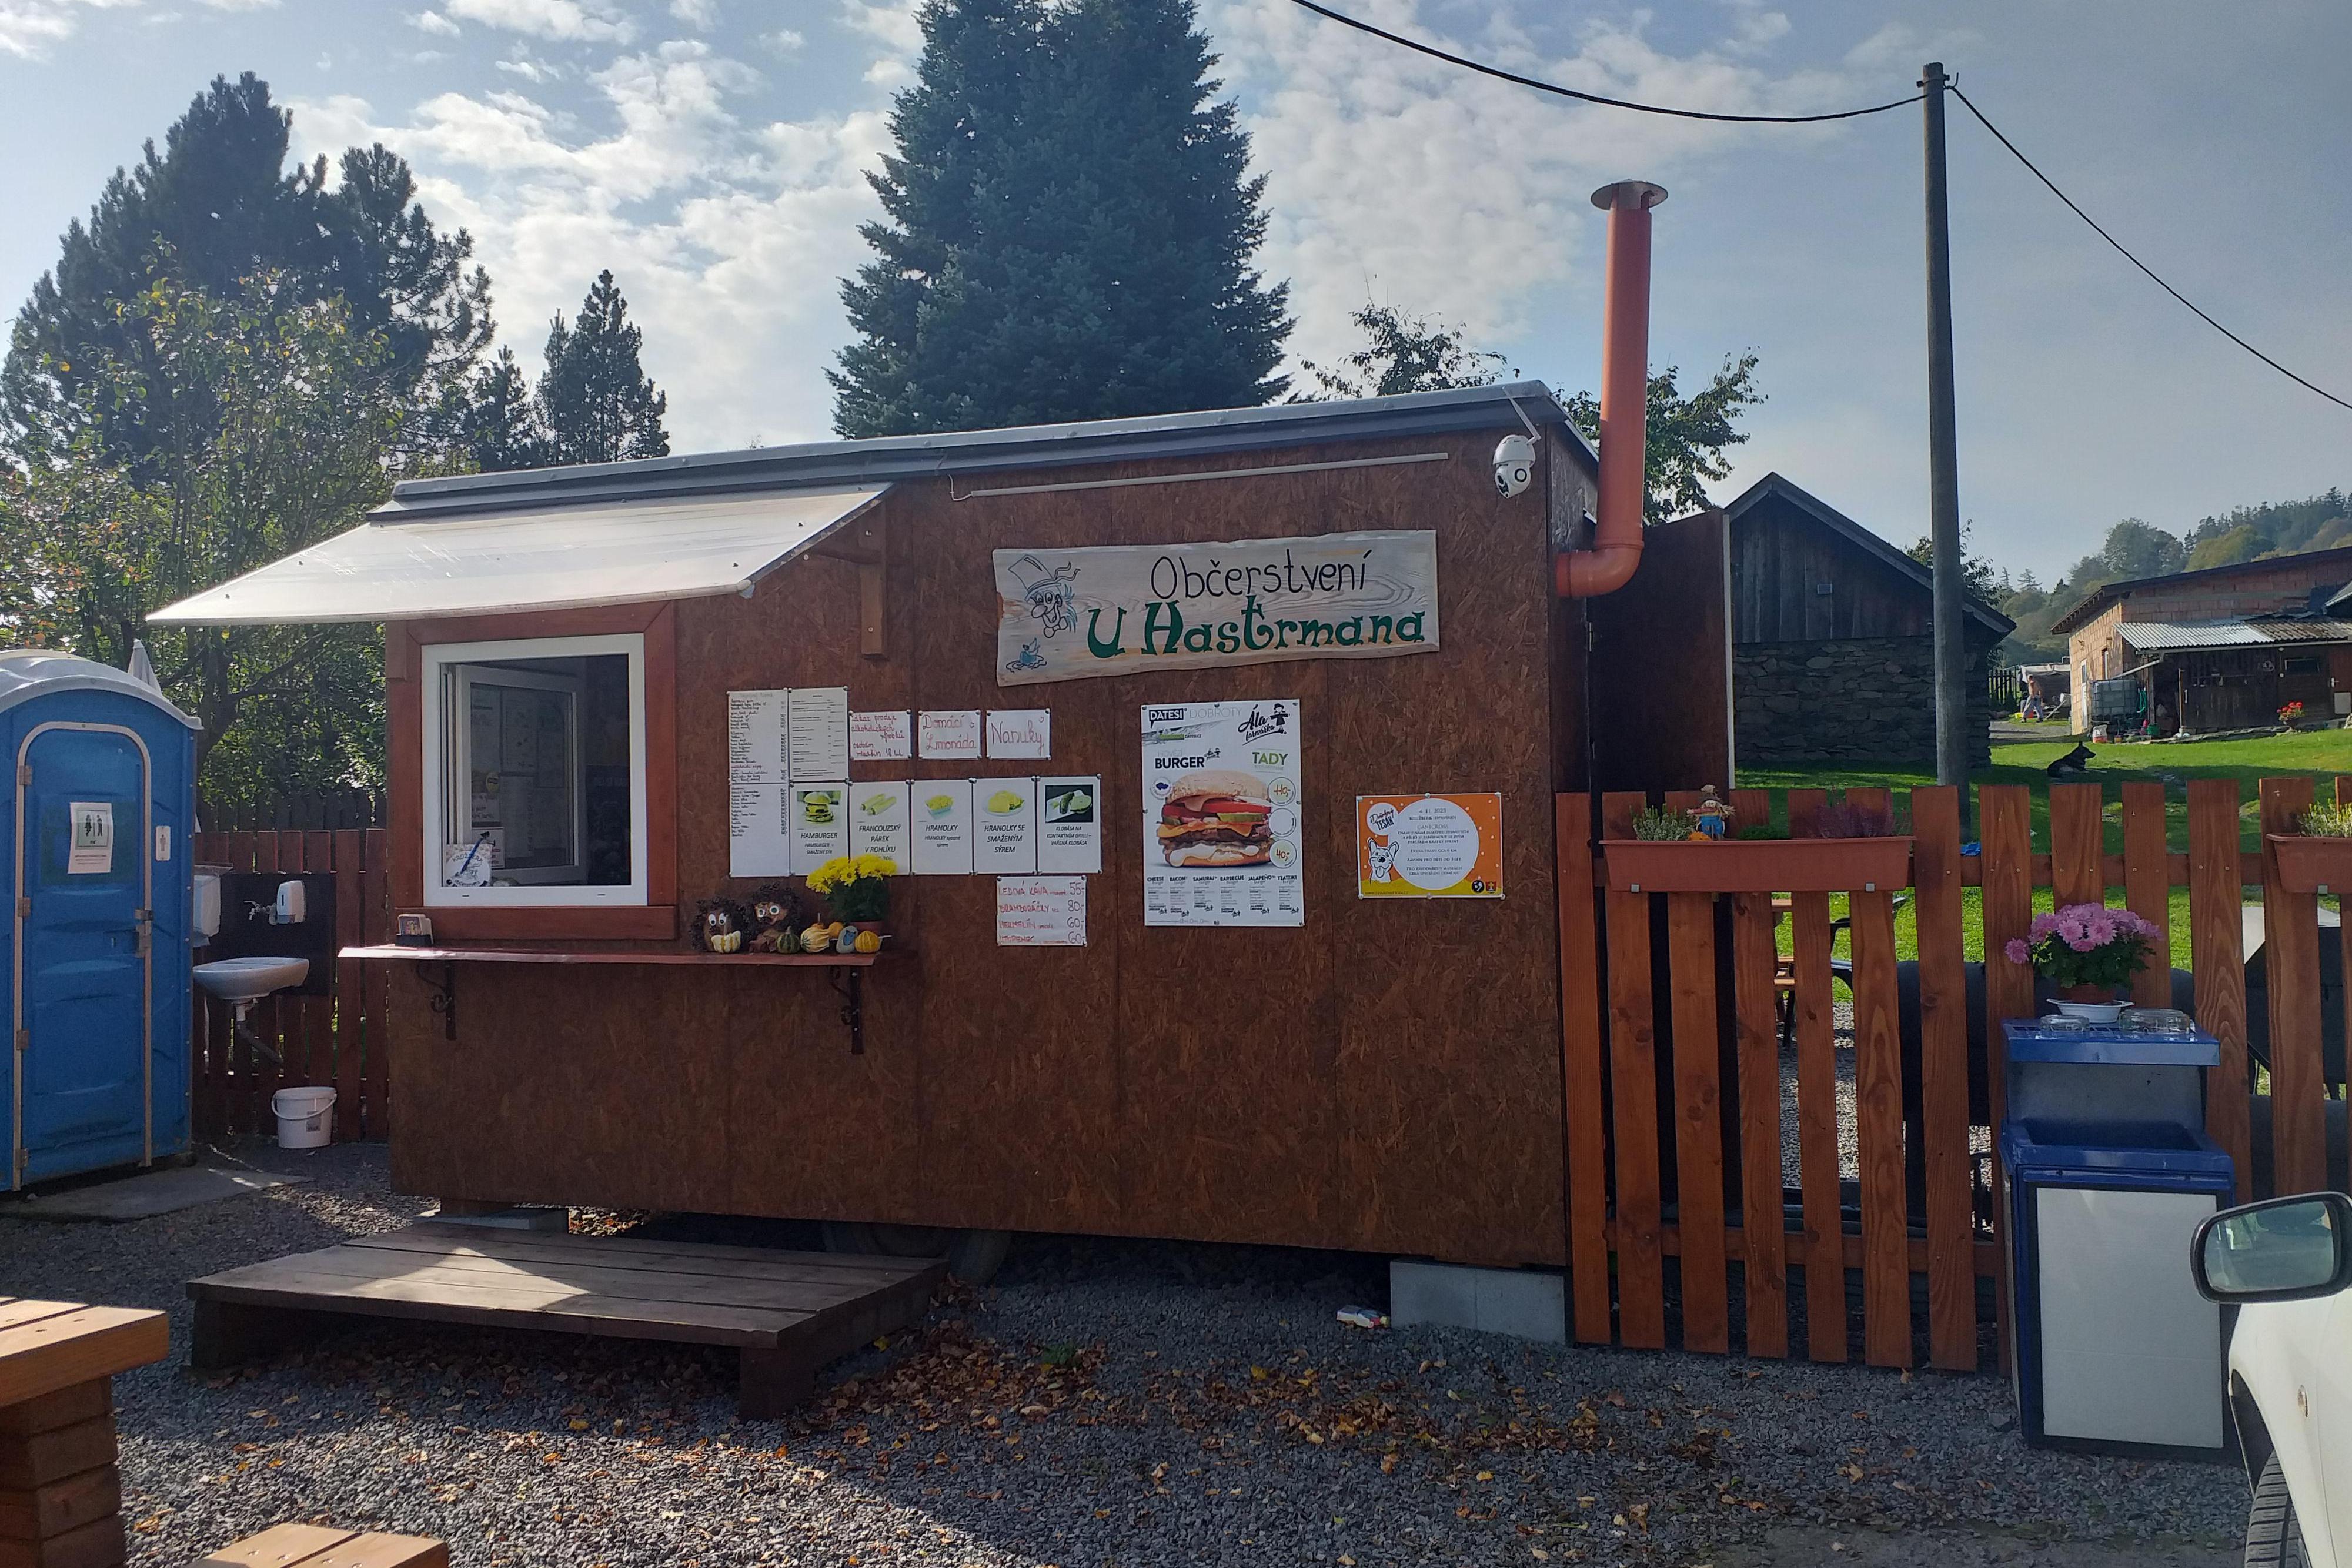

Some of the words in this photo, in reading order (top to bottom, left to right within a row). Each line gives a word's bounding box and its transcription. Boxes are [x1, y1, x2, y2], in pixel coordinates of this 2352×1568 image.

[1151, 549, 1372, 600] Občerstvení
[1087, 608, 1129, 658] U
[1141, 594, 1428, 656] Hastrmana
[1150, 710, 1182, 720] DATESI
[1190, 707, 1242, 718] DOBROTY
[1238, 704, 1268, 733] Ála
[923, 714, 965, 728] Domácí
[926, 732, 976, 750] Limonáda
[991, 720, 1044, 757] Nanuky
[885, 748, 892, 757] 18
[1252, 751, 1288, 765] TADY
[1155, 757, 1205, 769] BURGER
[859, 823, 901, 832] FRANCOUZSKÝ
[987, 834, 1023, 842] SMAŽENÝM
[870, 844, 896, 852] ROHLÍKU
[1000, 900, 1049, 913] BRAMBORÁČKY
